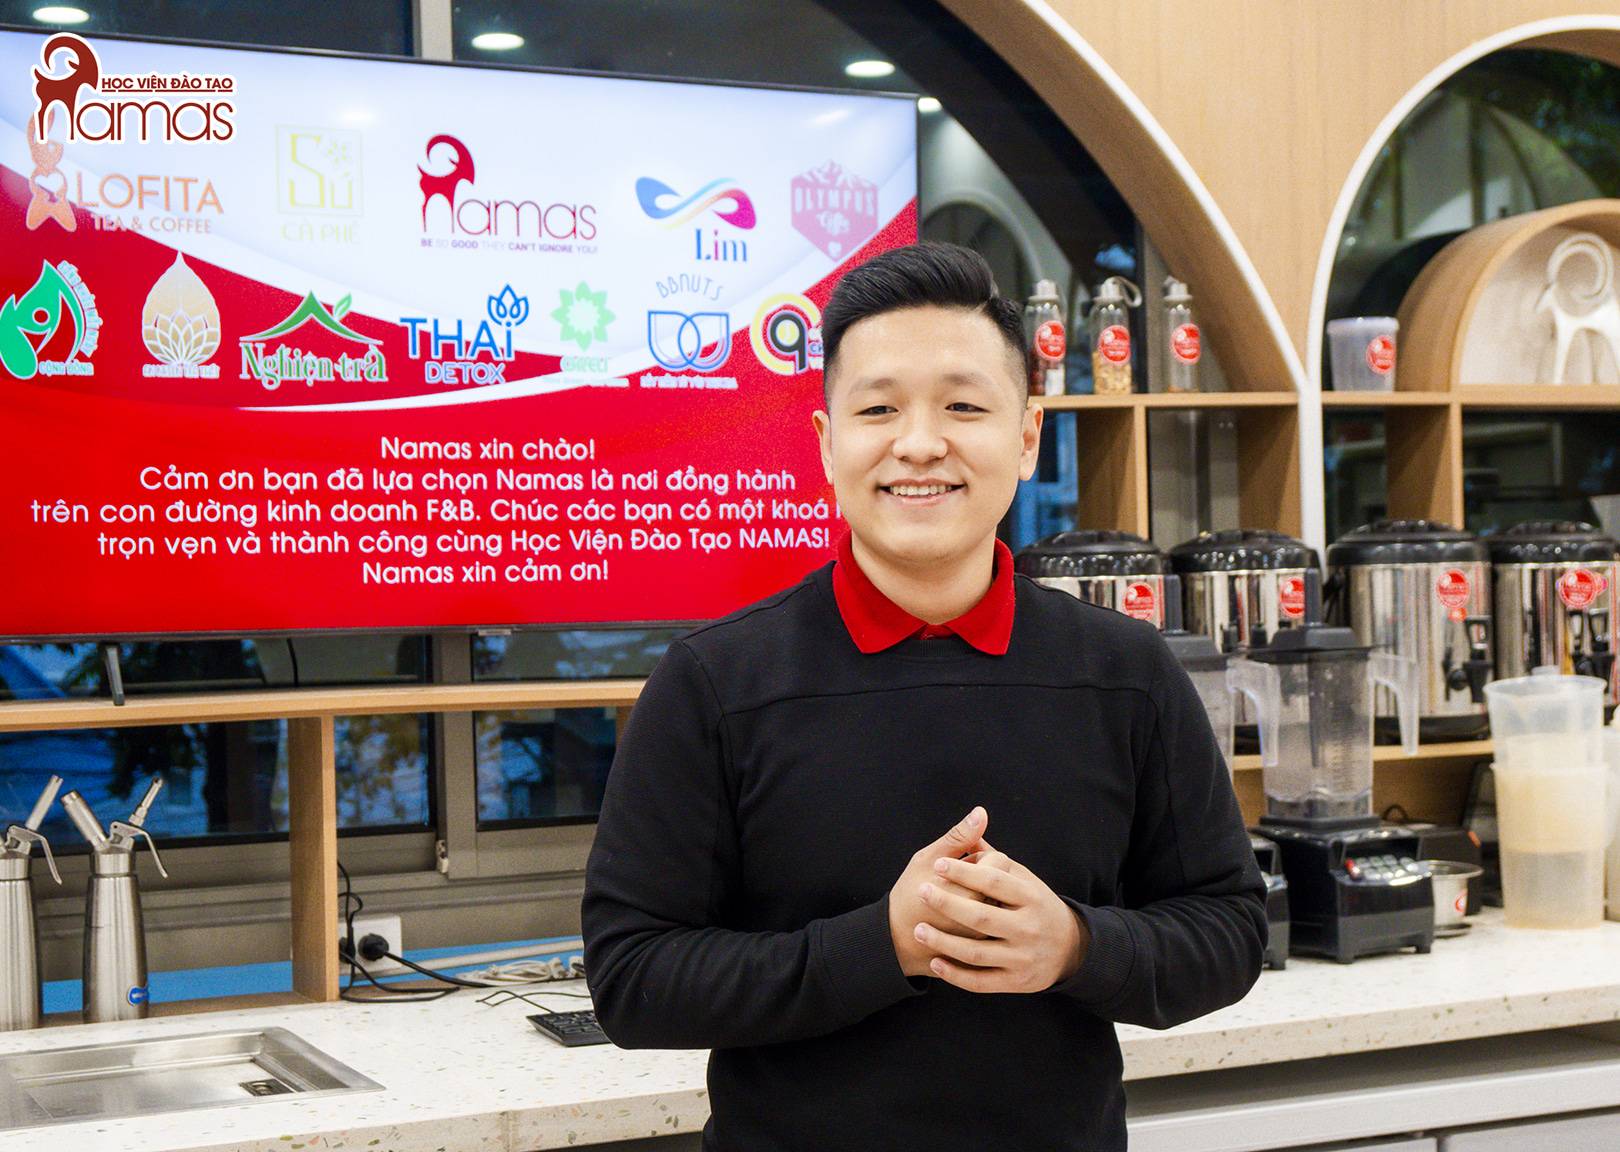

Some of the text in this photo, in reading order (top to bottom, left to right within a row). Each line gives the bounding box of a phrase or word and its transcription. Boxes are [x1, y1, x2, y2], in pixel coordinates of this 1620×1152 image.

[76, 171, 224, 214] LOFITA
[92, 214, 212, 234] TEA & COFFEE
[451, 239, 480, 249] GOOD
[695, 228, 748, 262] Lim
[425, 361, 506, 384] DETOX
[381, 437, 595, 461] Namas xin chào!
[139, 464, 796, 495] Cảm ơn bạn đã lựa chọn Namas là nơi đồng hành
[31, 499, 89, 523] trên
[99, 504, 155, 523] con
[165, 499, 258, 527] đường
[267, 499, 321, 522] kinh
[330, 499, 418, 522] doanh
[427, 498, 481, 522] F&B.
[490, 498, 559, 522] Chúc
[566, 498, 616, 522] các
[624, 498, 672, 526] bạn
[680, 498, 711, 521] có
[719, 498, 766, 524] một
[772, 498, 829, 520] khoá
[97, 527, 830, 559] trọn vẹn và thành công cùng Học Viện Đào Tạo NAMAS!
[363, 557, 609, 584] Namas xin cảm ơn!
